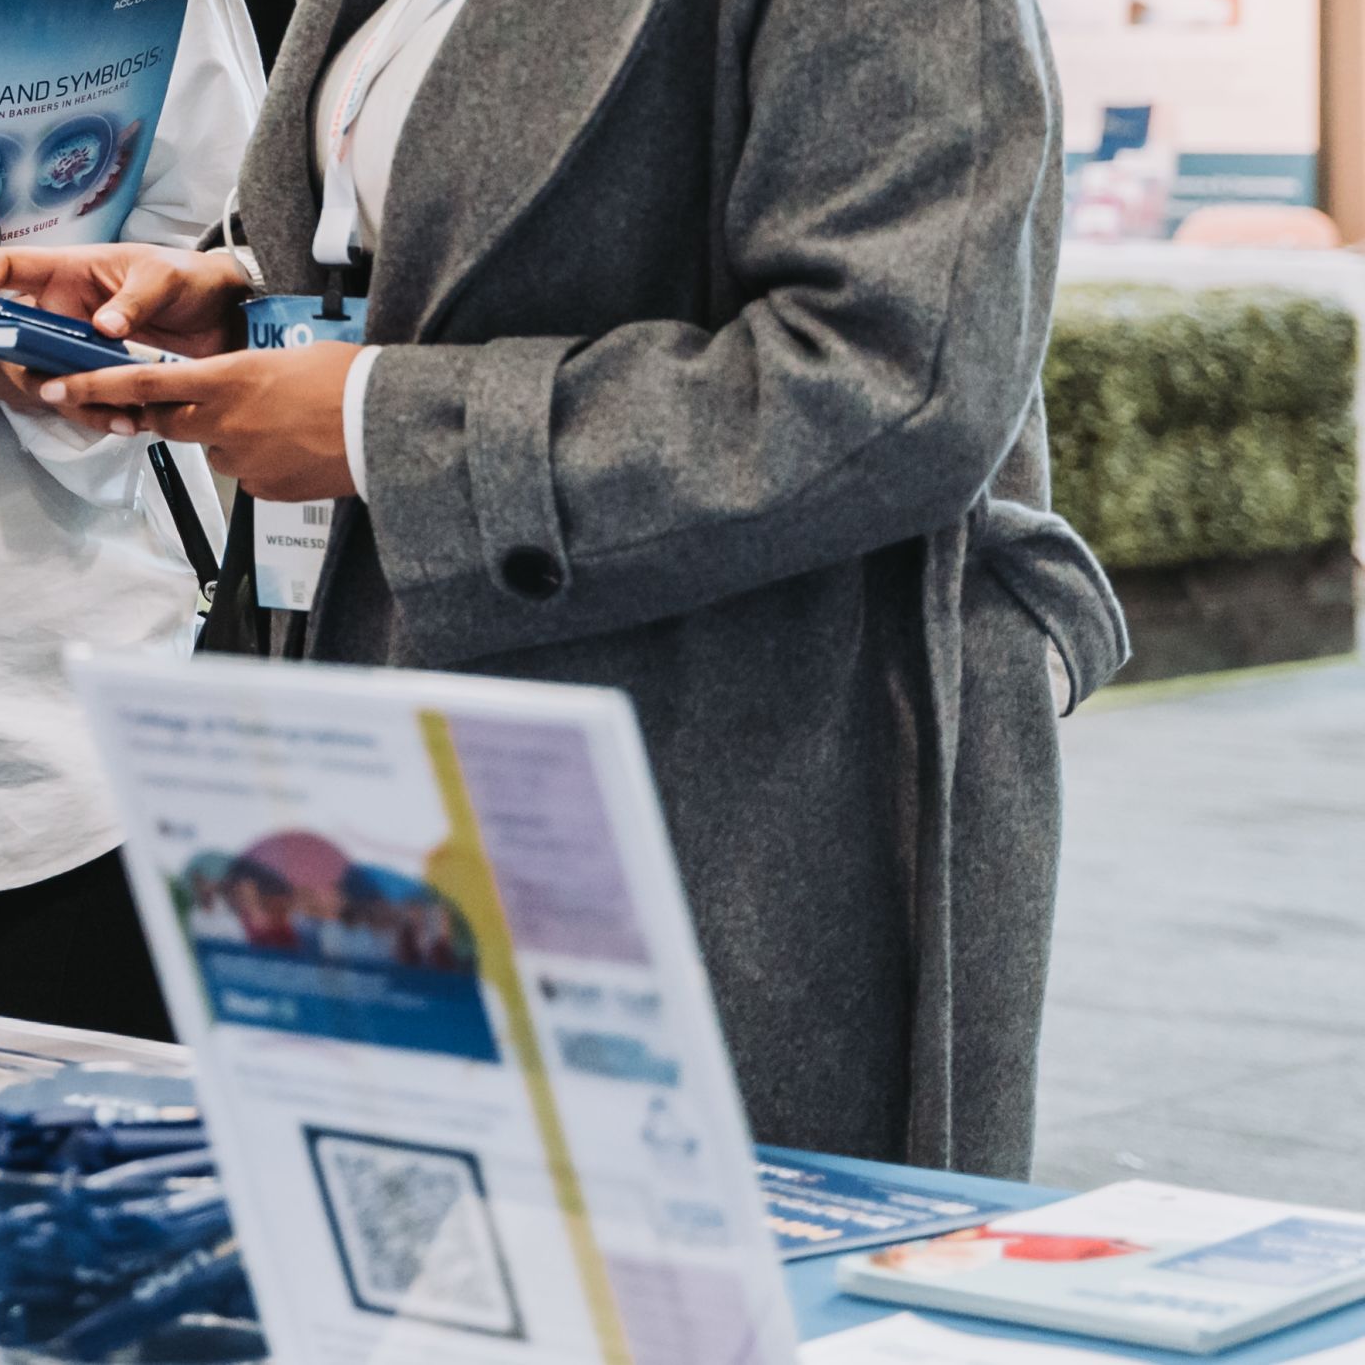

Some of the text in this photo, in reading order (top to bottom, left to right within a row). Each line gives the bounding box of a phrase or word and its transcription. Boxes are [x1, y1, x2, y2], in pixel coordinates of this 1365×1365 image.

[55, 45, 163, 97] SYMBIOSIS:
[9, 103, 60, 118] BARRIERS
[61, 99, 72, 108] IN
[74, 79, 131, 105] HEALTHCARE
[33, 217, 59, 232] GUIDE
